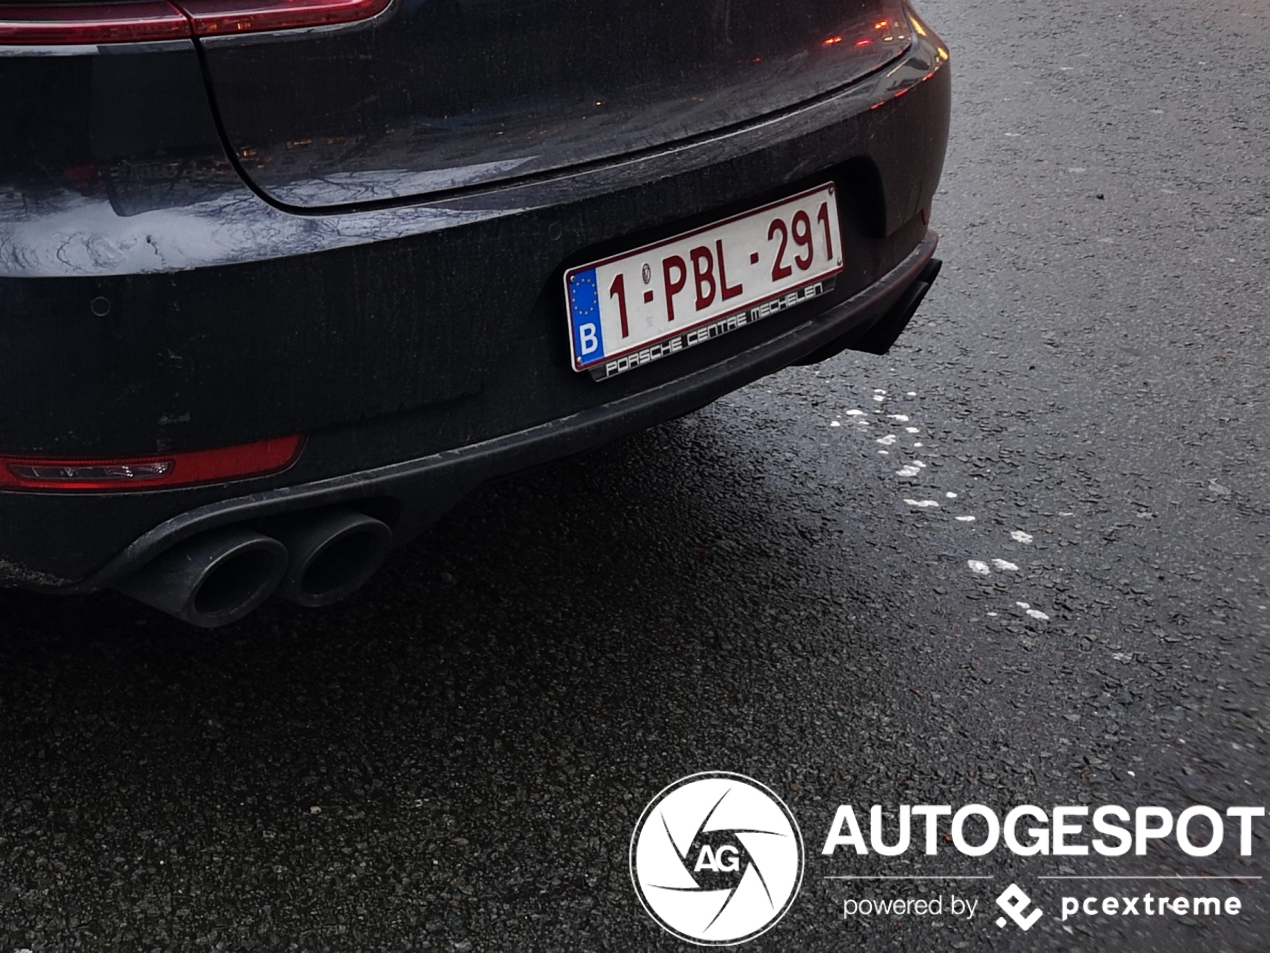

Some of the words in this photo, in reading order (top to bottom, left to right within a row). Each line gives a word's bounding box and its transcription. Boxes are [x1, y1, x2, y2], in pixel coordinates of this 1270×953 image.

[579, 322, 599, 356] B
[605, 339, 683, 377] PORSCHE
[686, 312, 748, 349] CENTRE
[750, 281, 825, 322] MECHELEN
